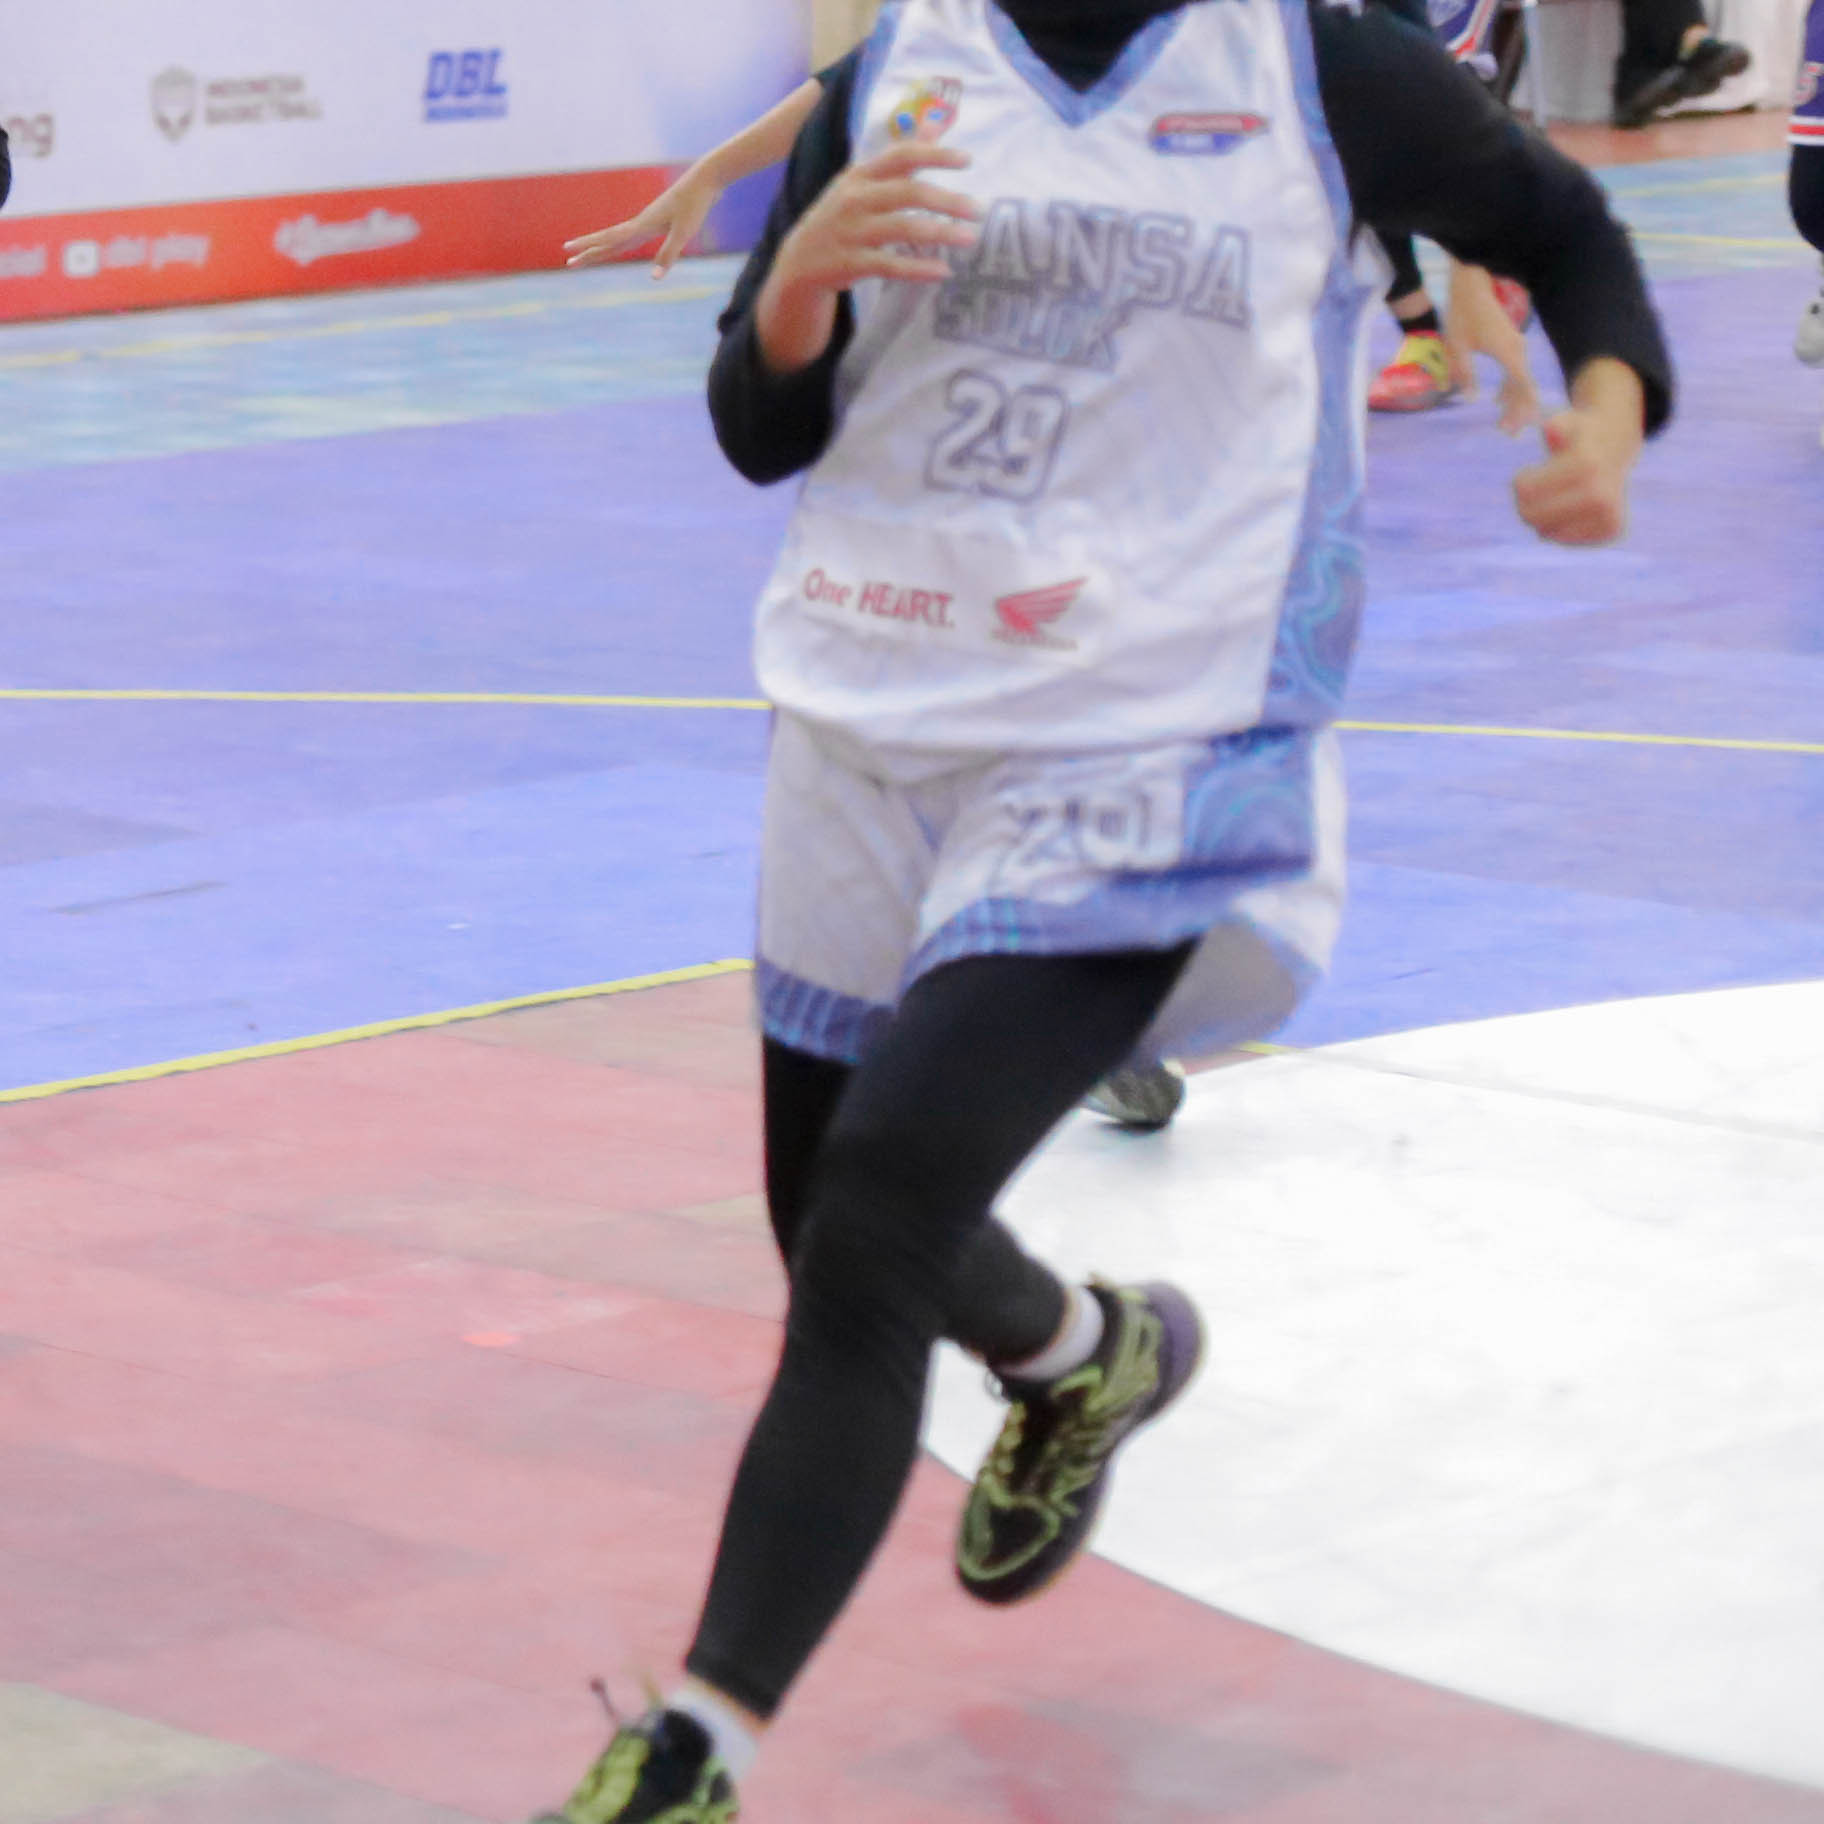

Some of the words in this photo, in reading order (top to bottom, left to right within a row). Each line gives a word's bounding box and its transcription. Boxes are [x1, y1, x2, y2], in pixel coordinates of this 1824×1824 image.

[424, 49, 507, 100] DBL
[968, 196, 1255, 331] ANSA
[923, 367, 1071, 503] 29
[804, 567, 853, 606] One
